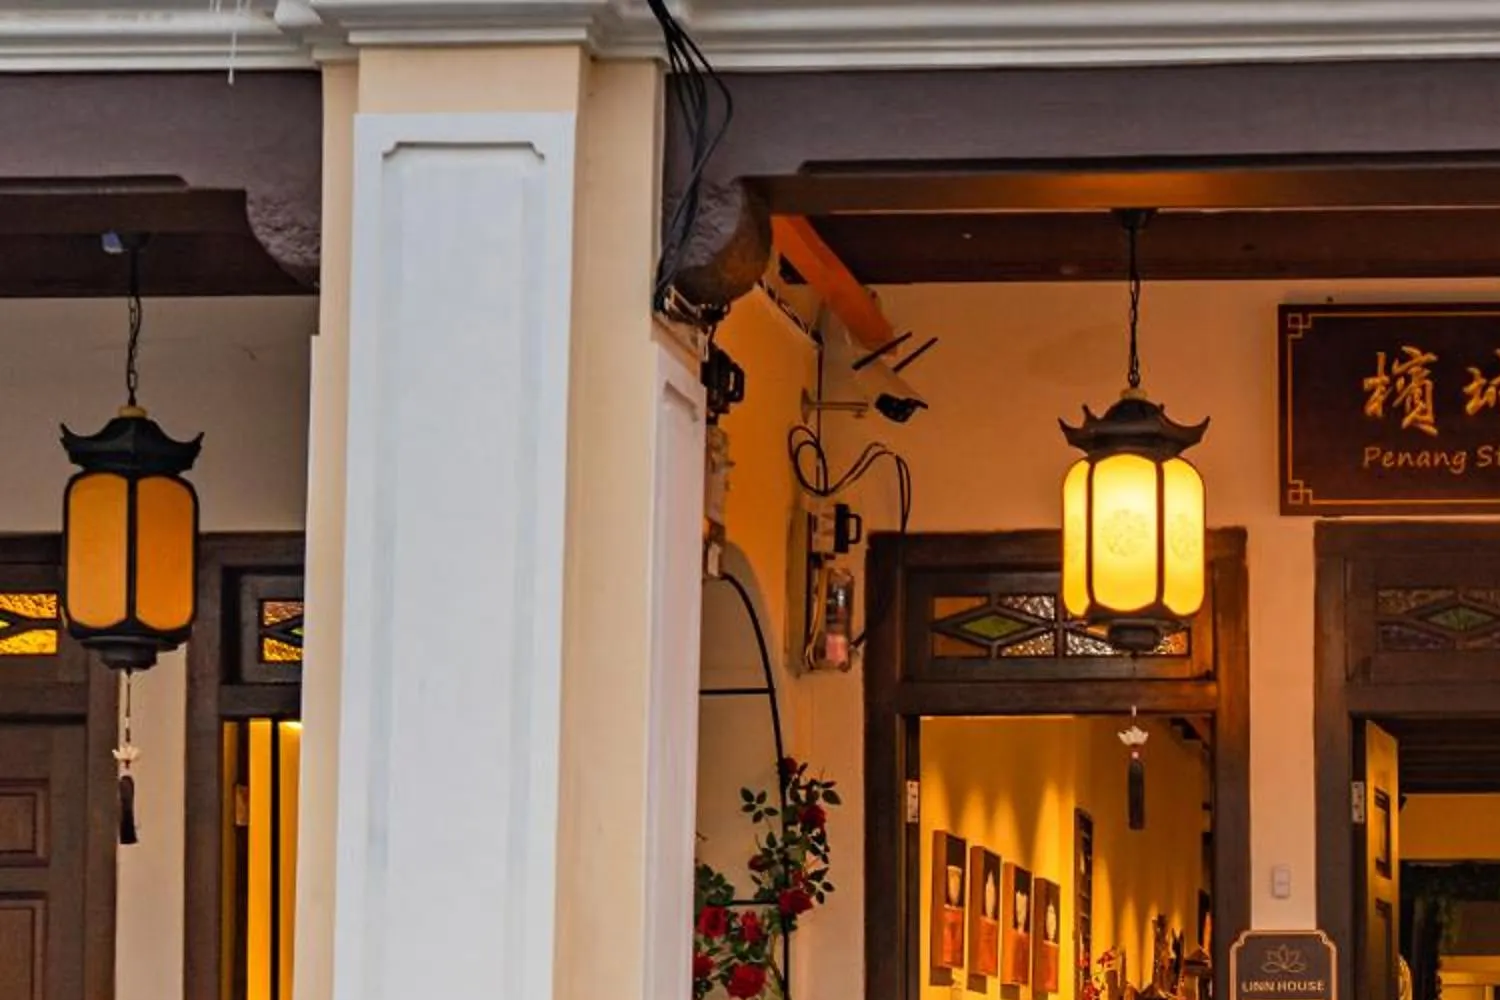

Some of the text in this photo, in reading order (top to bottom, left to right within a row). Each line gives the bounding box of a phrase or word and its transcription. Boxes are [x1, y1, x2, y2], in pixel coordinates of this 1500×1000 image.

[1362, 445, 1468, 475] Penang
[1241, 980, 1325, 993] LINN HOUSE
